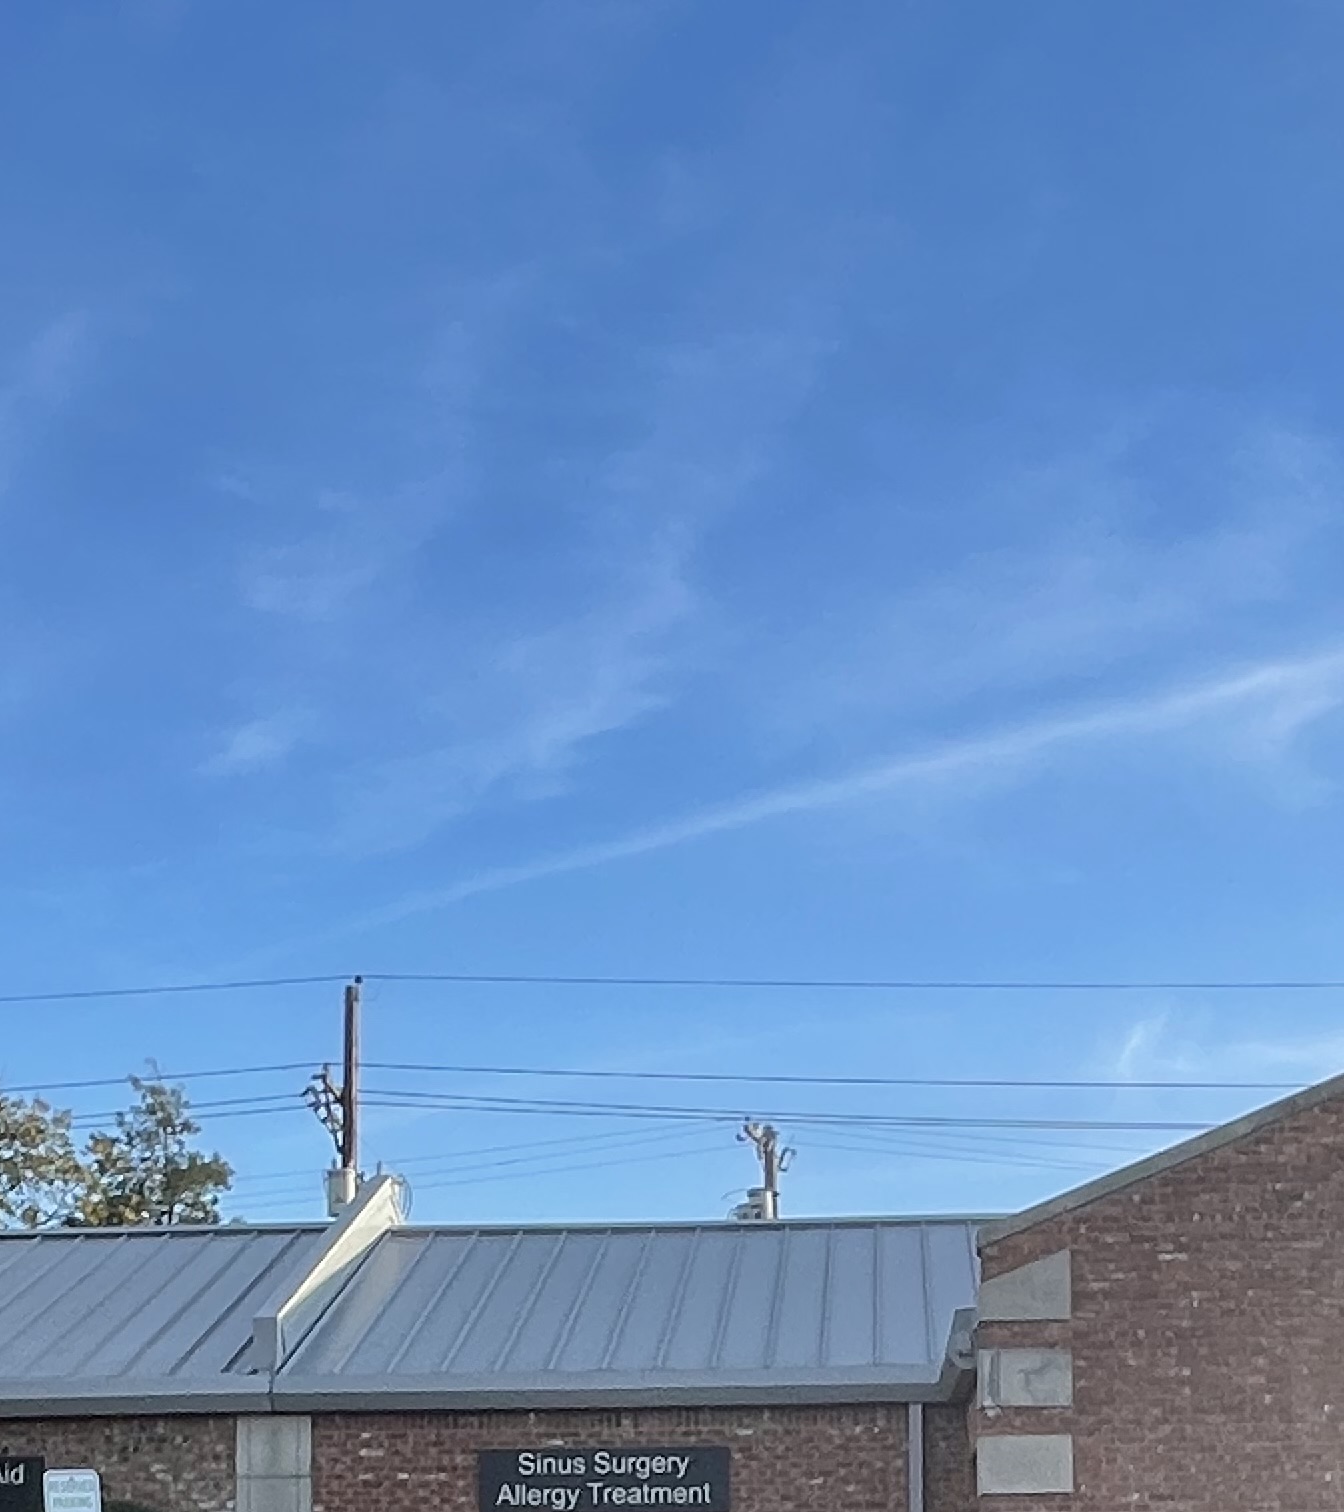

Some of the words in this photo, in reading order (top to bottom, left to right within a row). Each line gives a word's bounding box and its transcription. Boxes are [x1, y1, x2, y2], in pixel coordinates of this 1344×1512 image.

[518, 1453, 586, 1476] Sinus
[594, 1452, 689, 1479] Surgery
[495, 1484, 581, 1510] Allergy
[587, 1482, 711, 1505] Treatment
